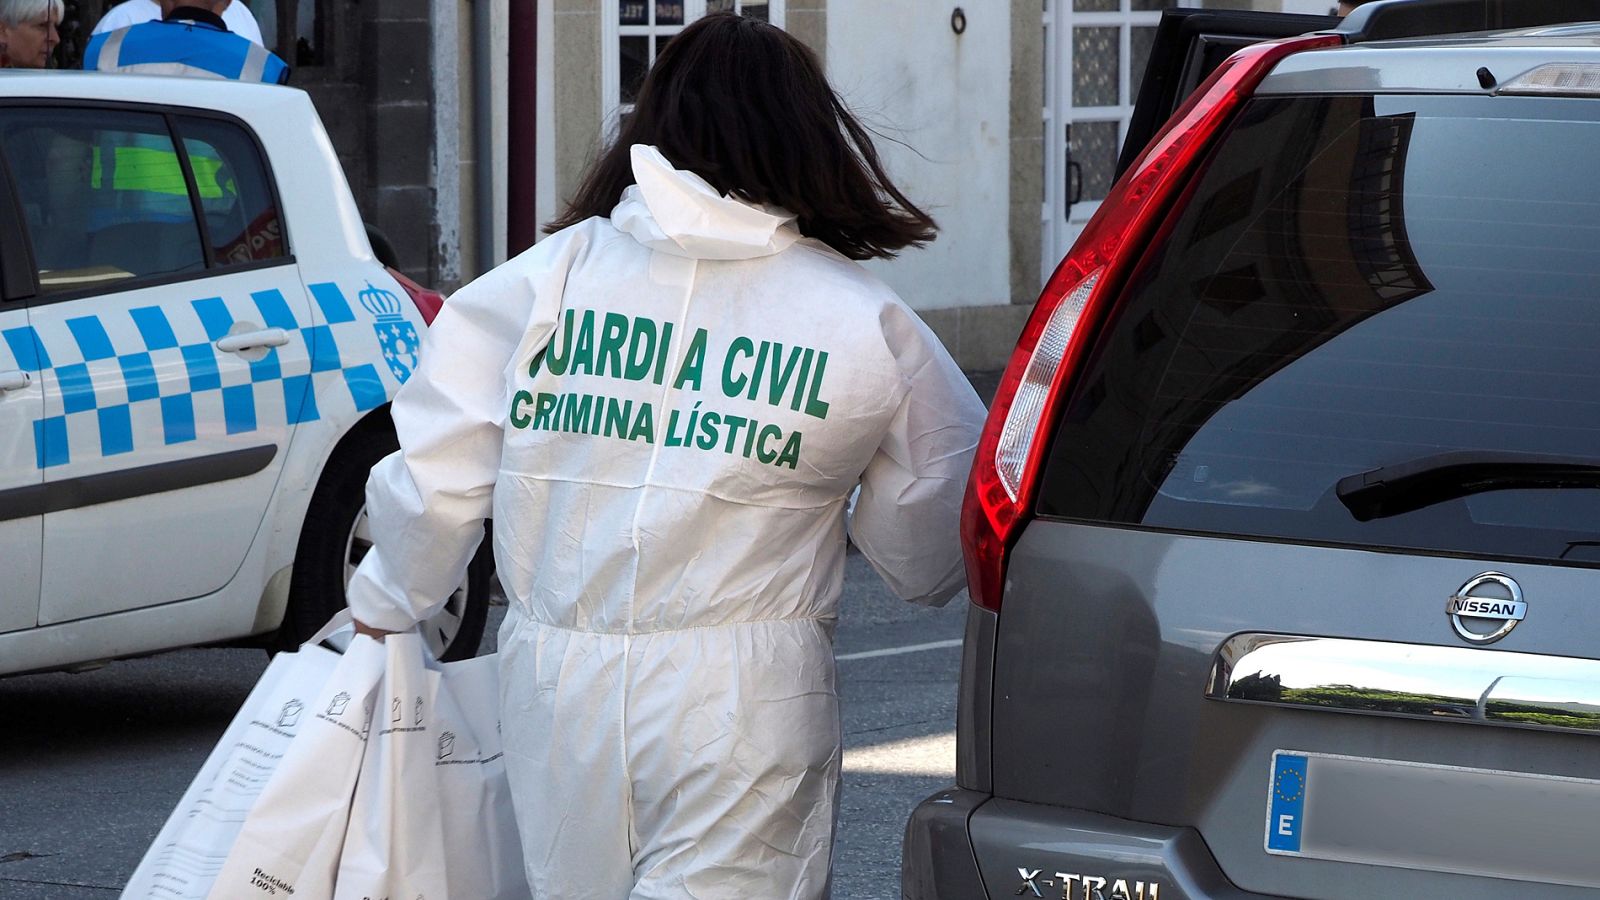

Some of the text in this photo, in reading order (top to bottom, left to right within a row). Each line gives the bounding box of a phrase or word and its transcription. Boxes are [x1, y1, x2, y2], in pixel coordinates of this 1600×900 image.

[721, 336, 830, 420] CIVIL
[1452, 600, 1516, 615] NISSAN
[1278, 814, 1294, 836] E
[250, 877, 276, 895] 100%
[254, 868, 295, 895] Reciclable
